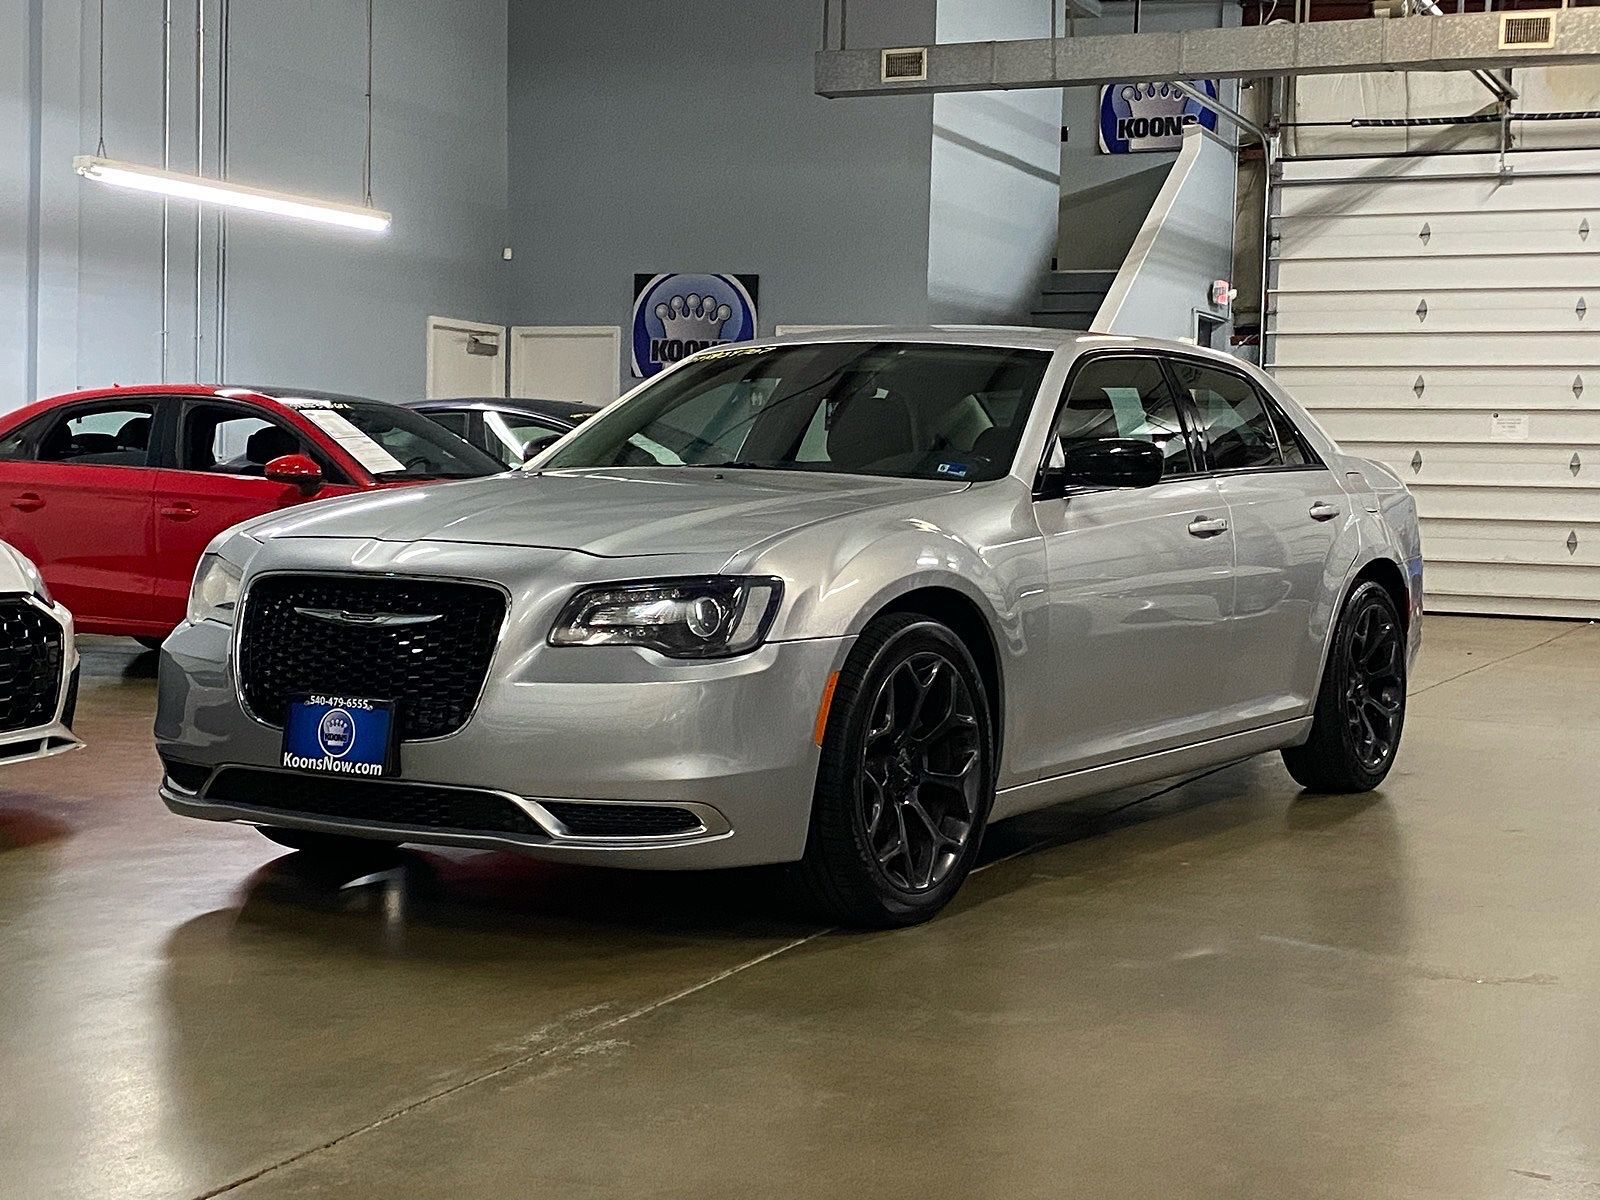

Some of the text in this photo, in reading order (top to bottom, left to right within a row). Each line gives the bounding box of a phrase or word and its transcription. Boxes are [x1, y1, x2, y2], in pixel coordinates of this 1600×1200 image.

[651, 339, 731, 362] KOO
[310, 695, 369, 709] 540-479-6555
[283, 752, 382, 776] KoonsNow.com
